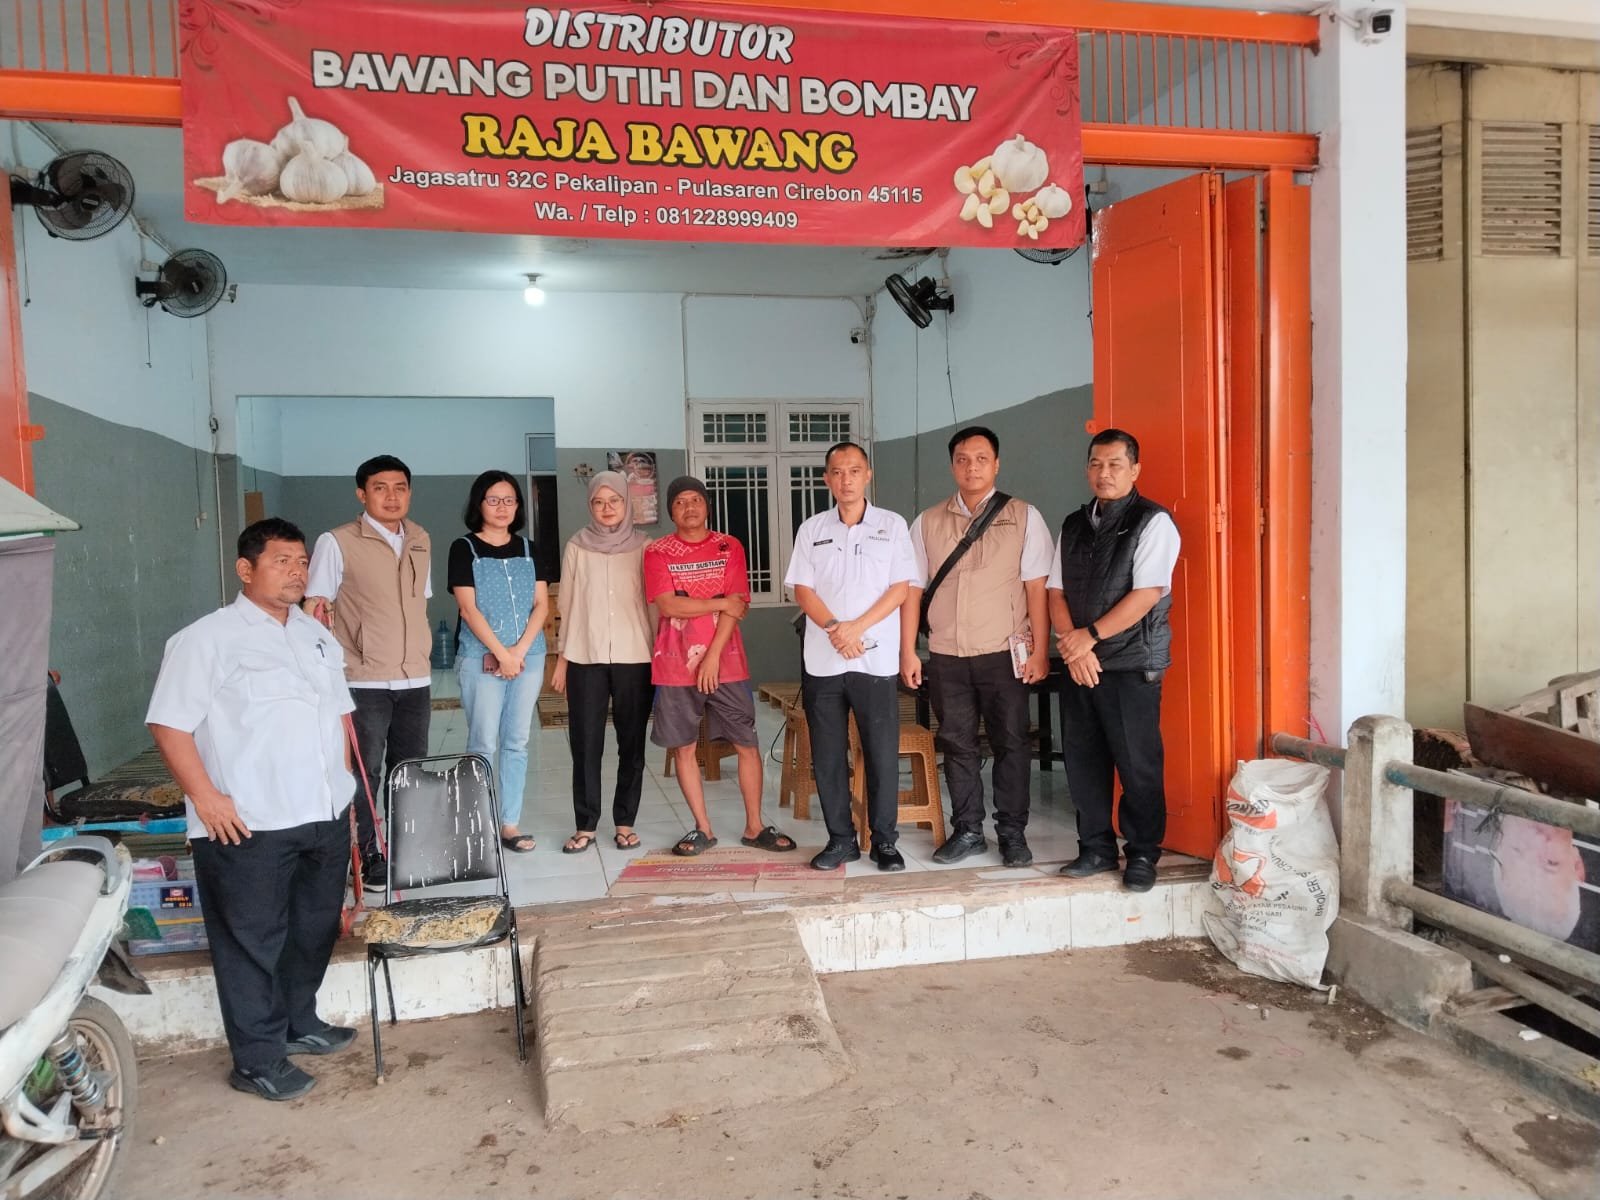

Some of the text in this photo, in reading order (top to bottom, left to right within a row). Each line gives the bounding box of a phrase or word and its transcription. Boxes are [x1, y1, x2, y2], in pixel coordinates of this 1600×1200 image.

[524, 7, 794, 64] DISTRIBUTOR
[312, 49, 977, 121] BAWANG PUTIH DAN BOMBAY
[461, 113, 857, 173] RAJA BAWANG
[389, 166, 500, 189] Jagasatru
[506, 171, 548, 189] 32C
[555, 172, 659, 196] Pekalipan
[677, 178, 779, 199] Pulasaren
[785, 183, 862, 202] Cirebon
[867, 186, 923, 204] 45115
[534, 202, 798, 228] Wa. / Telp : 081228999409
